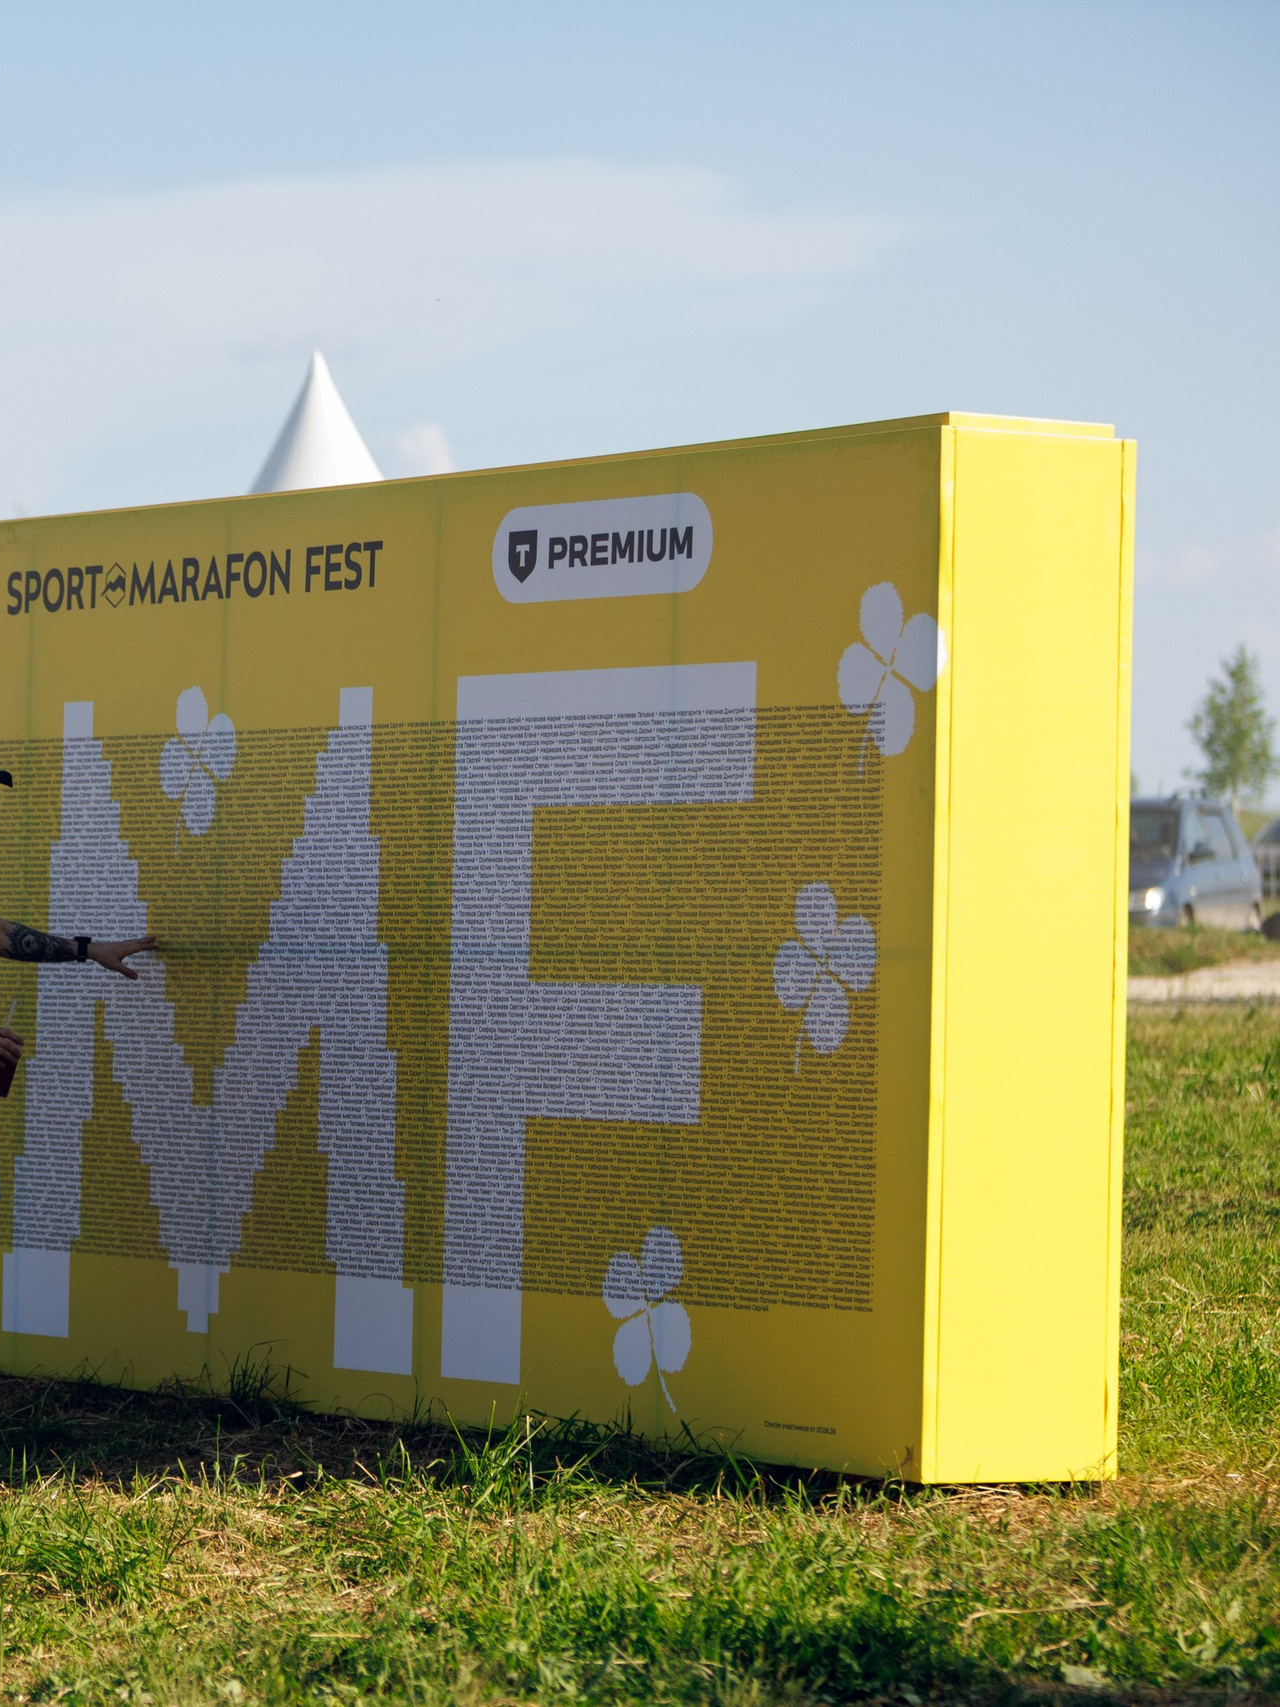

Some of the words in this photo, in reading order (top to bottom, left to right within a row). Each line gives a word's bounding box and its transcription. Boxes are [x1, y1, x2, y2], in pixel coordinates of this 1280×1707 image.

[548, 526, 693, 569] PREMIUM
[7, 565, 104, 615] SPORT
[129, 549, 291, 606] MARAFON
[305, 540, 383, 592] FEST
